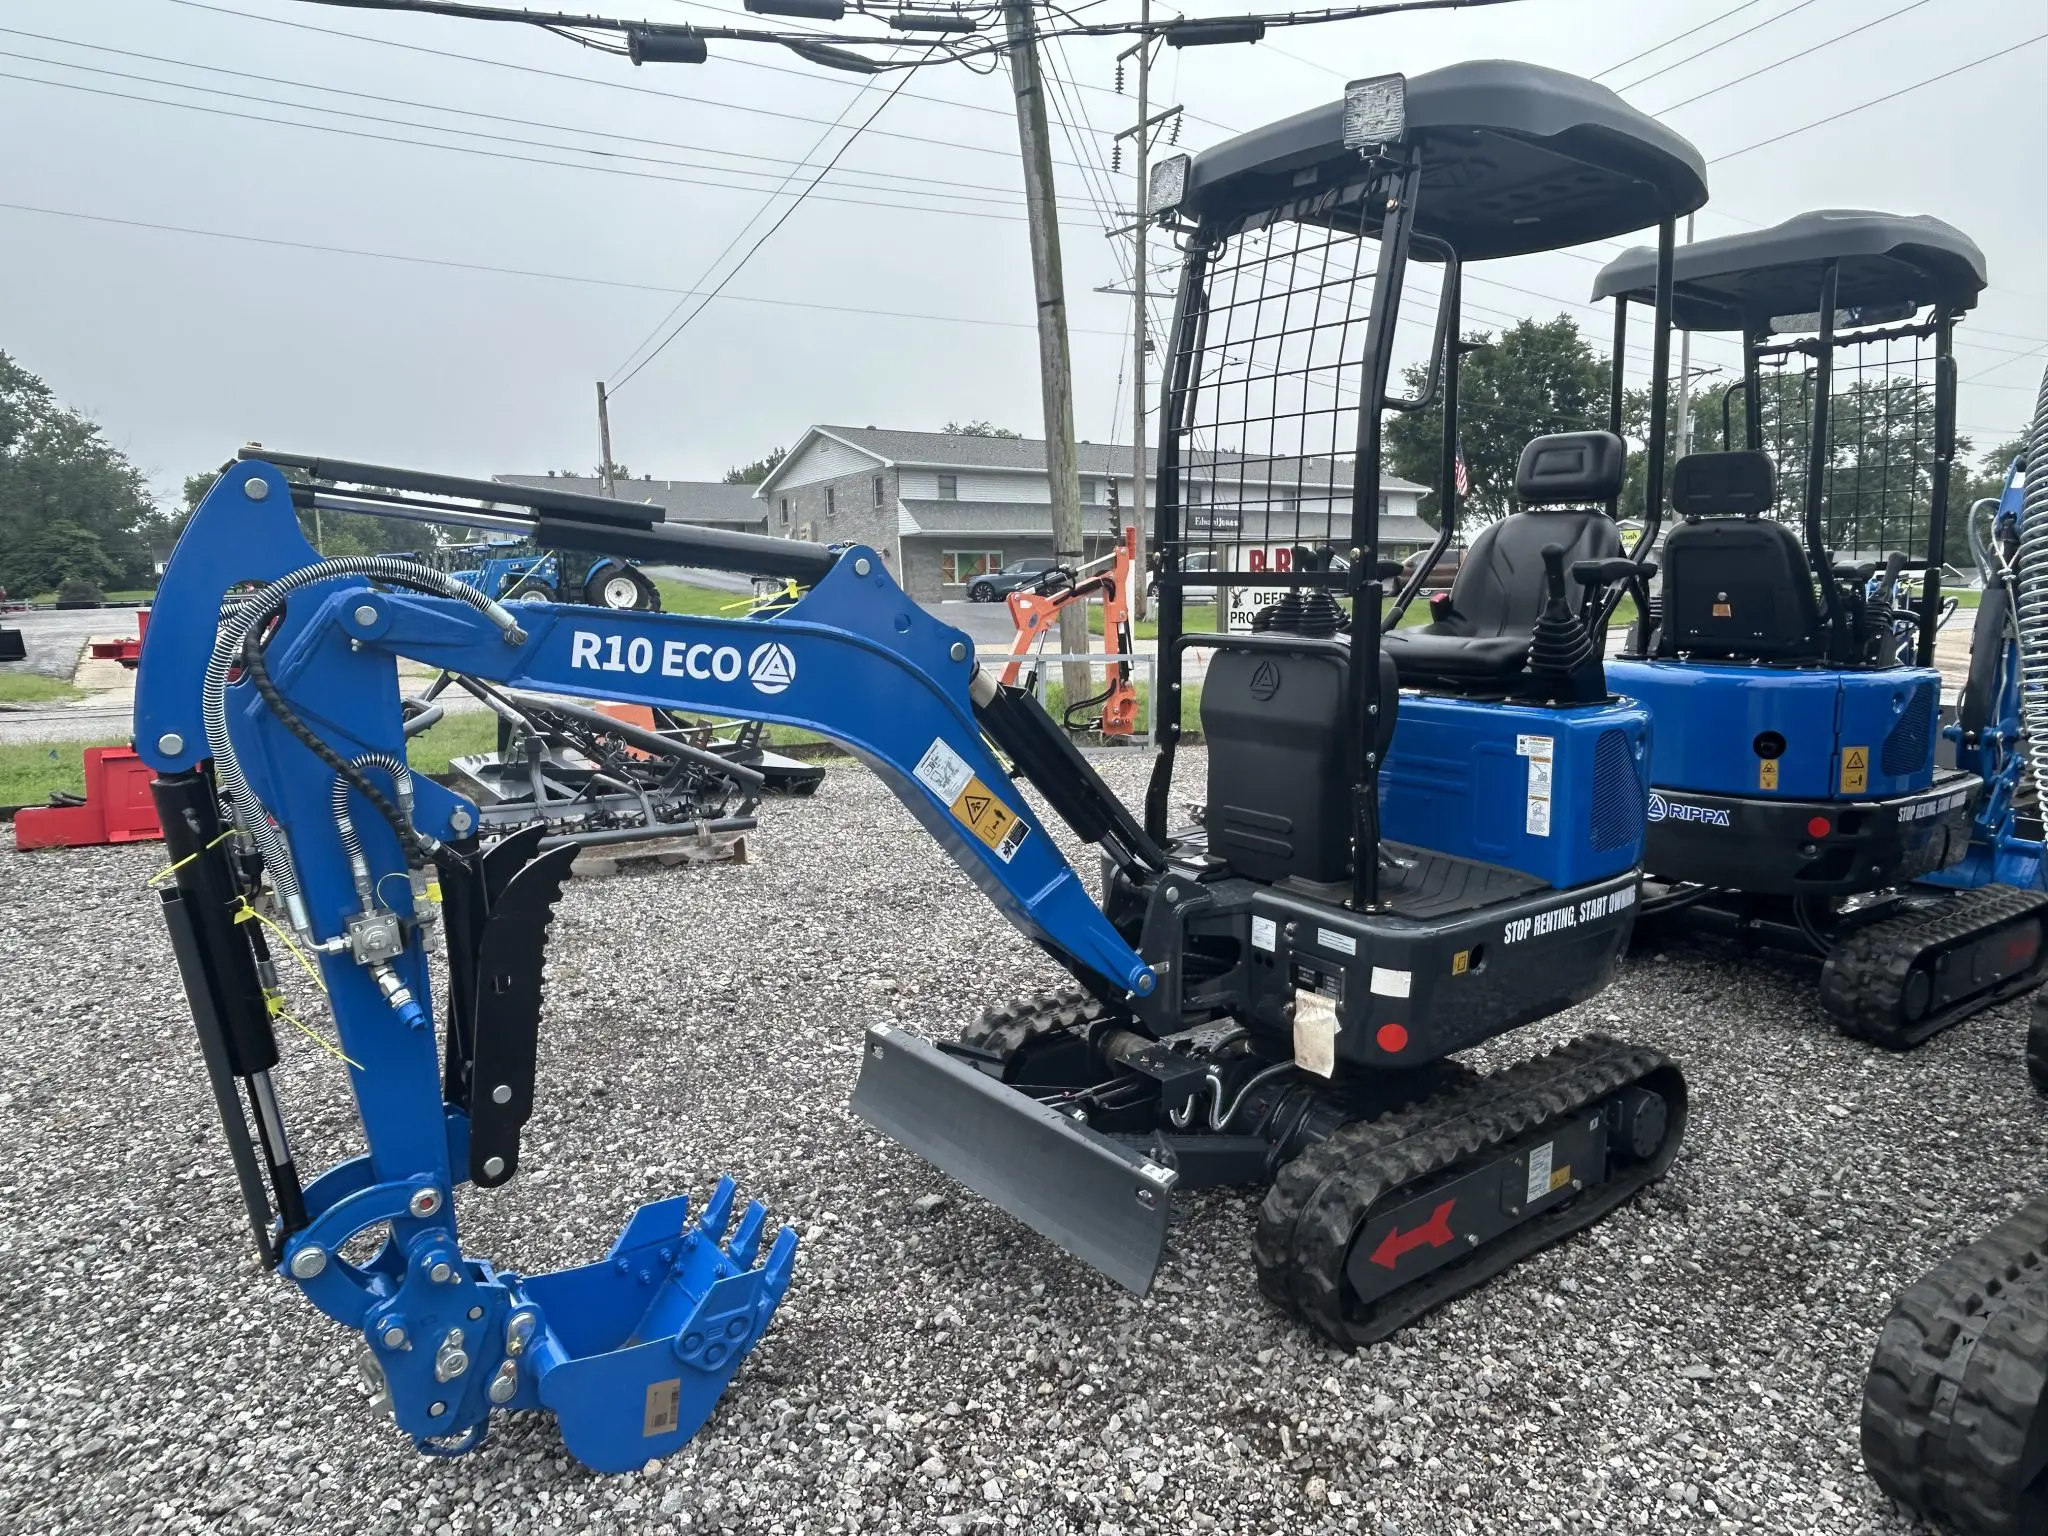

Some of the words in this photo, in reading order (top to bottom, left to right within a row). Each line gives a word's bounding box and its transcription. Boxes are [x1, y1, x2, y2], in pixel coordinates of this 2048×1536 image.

[571, 630, 653, 675] R10
[661, 640, 742, 682] ECO
[1669, 803, 1730, 826] RIPPA
[1504, 917, 1532, 944] STOP
[1533, 905, 1577, 936] RENTING,
[1580, 895, 1608, 923] START
